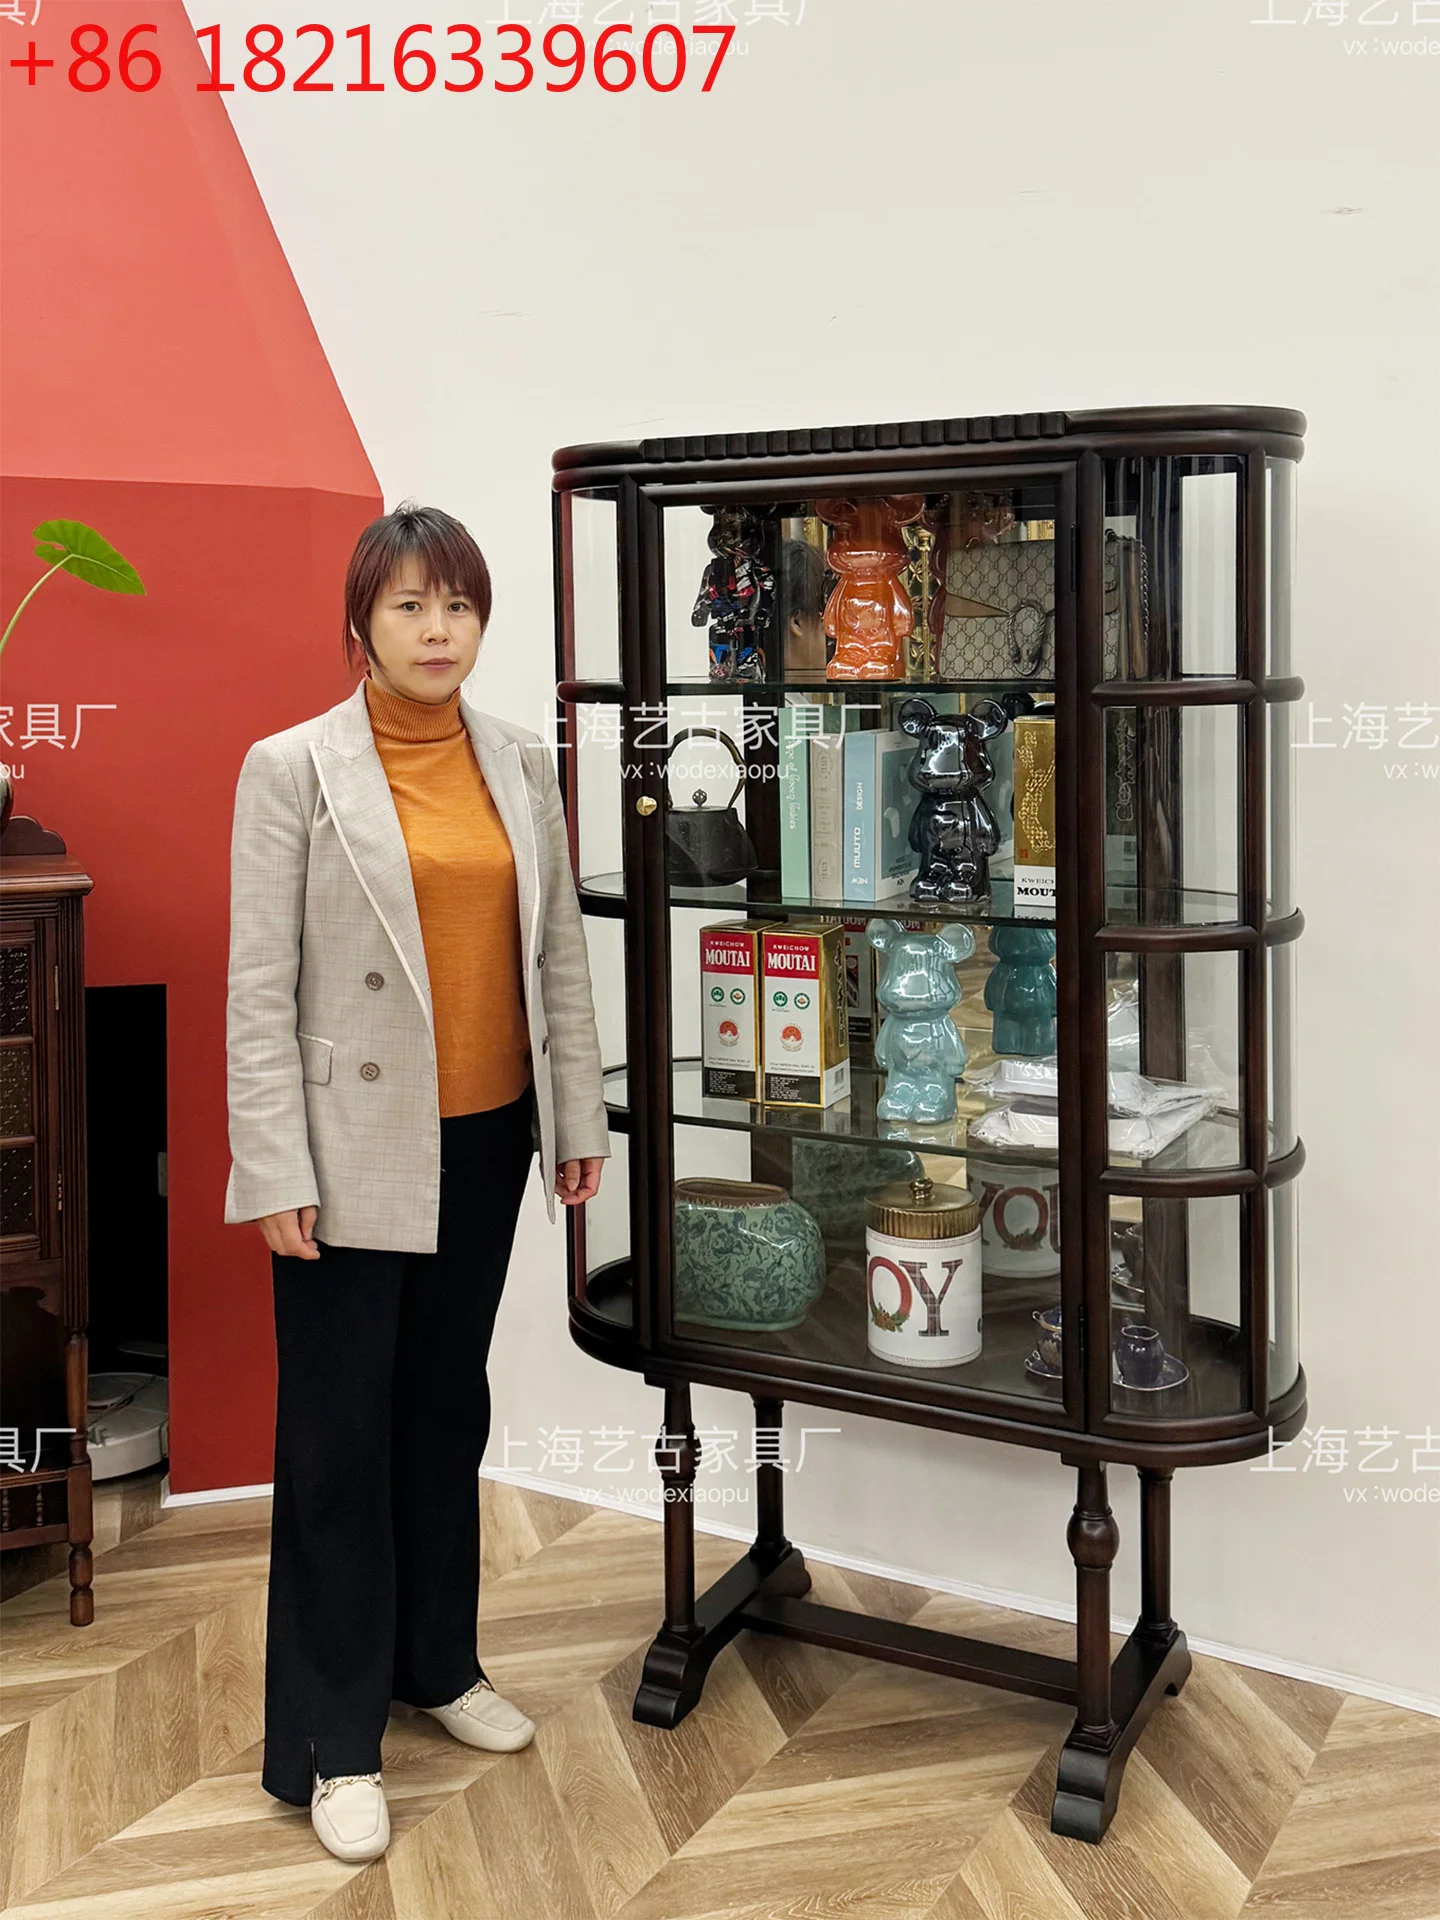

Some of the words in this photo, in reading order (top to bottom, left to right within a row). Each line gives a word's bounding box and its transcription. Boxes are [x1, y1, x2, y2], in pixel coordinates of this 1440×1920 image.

[856, 782, 864, 811] DESIGN
[710, 940, 745, 948] KWEICHOW
[773, 944, 810, 952] KWEICHOW
[705, 948, 751, 968] MOUTAI
[767, 952, 816, 972] MOUTAI
[867, 1255, 964, 1338] OY
